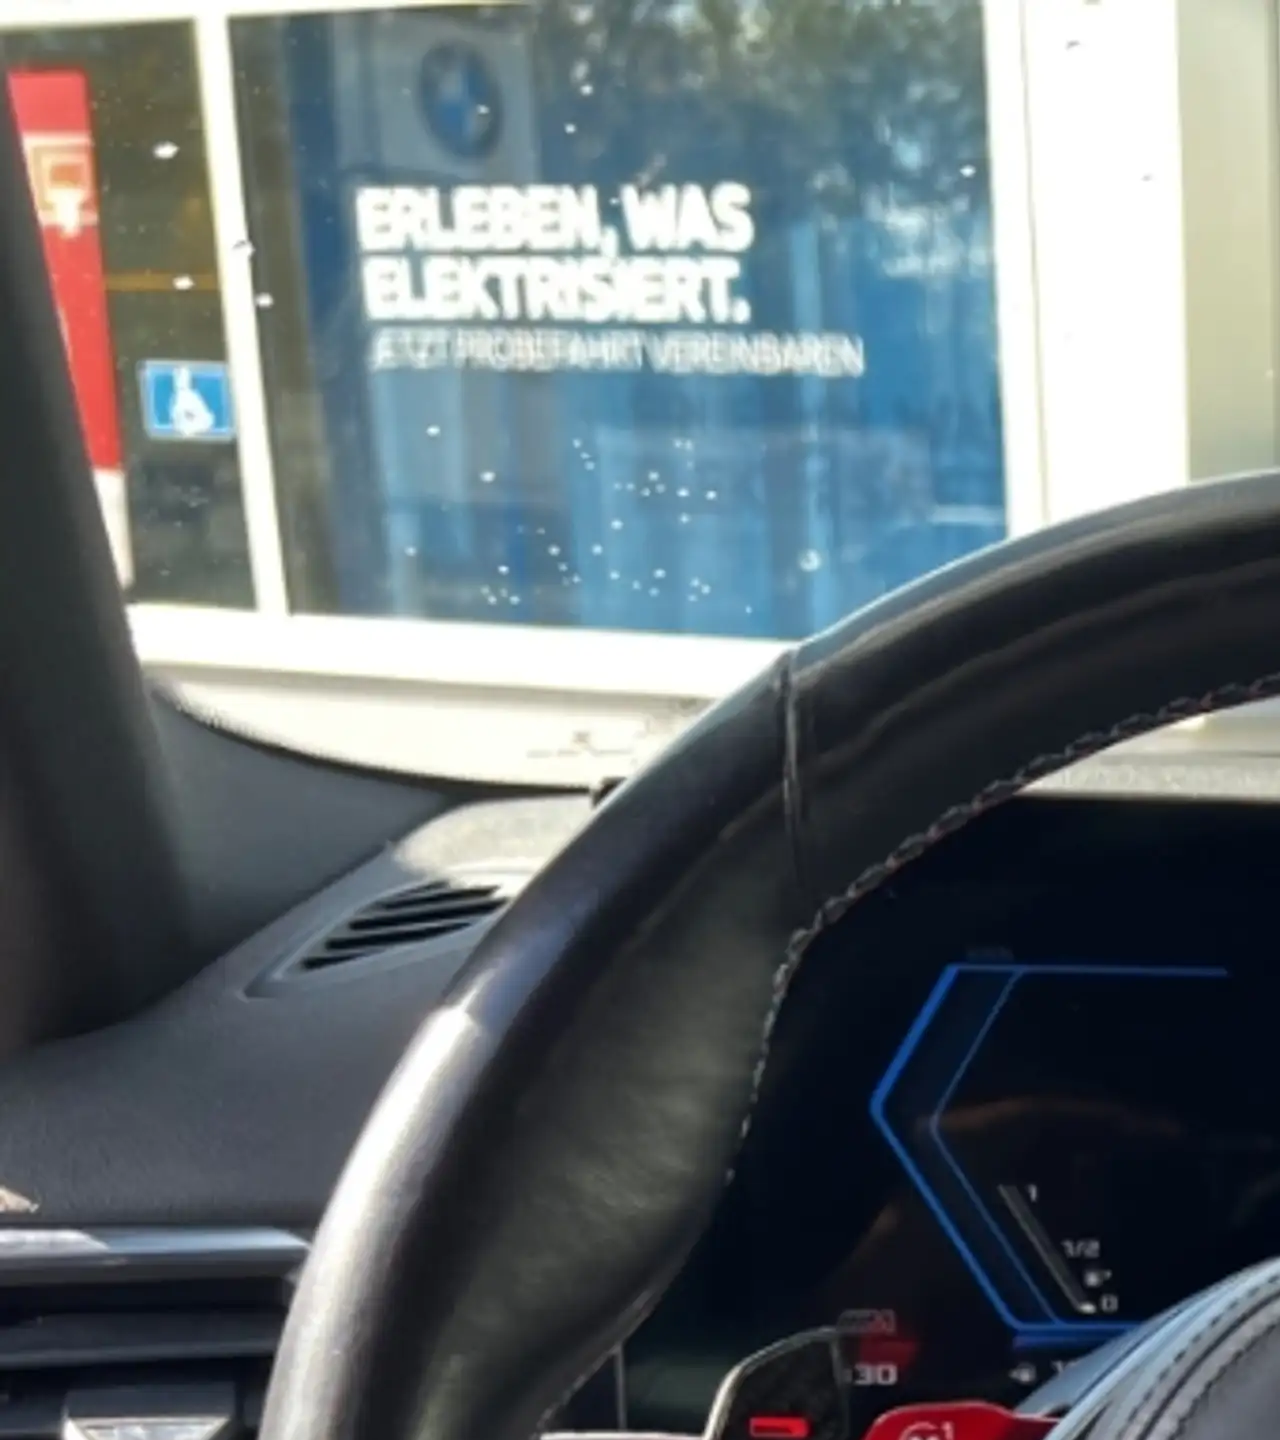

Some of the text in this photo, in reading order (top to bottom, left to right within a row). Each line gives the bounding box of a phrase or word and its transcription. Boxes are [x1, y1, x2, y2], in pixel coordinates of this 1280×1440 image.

[355, 181, 755, 258] ERLEBEN, WAS
[363, 255, 752, 322] ELEKTRISIERT.
[455, 329, 644, 374] PROBEFAHRT
[647, 331, 865, 378] VEREINBAREN
